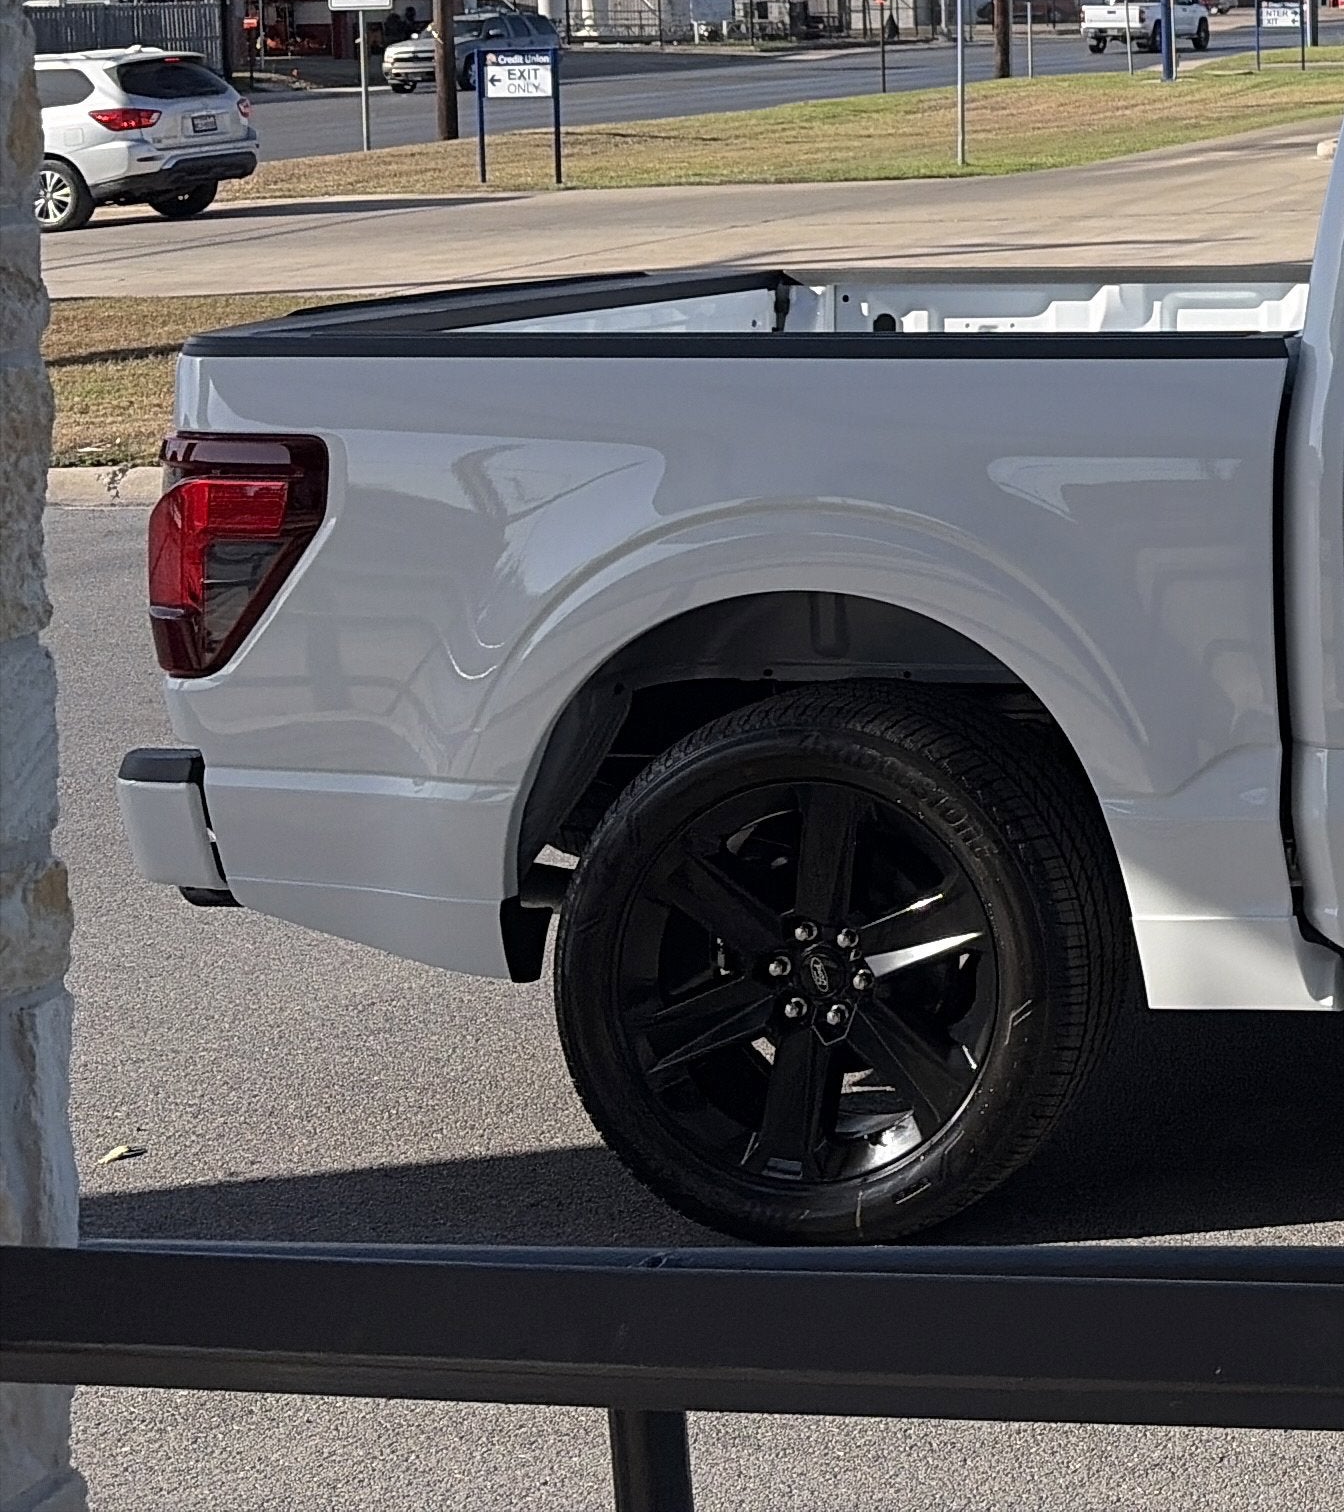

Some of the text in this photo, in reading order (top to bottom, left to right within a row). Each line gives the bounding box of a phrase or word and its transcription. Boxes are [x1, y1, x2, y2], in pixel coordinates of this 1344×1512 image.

[497, 54, 550, 65] Credit Union
[507, 68, 540, 81] EXIT
[507, 83, 541, 94] ONLY
